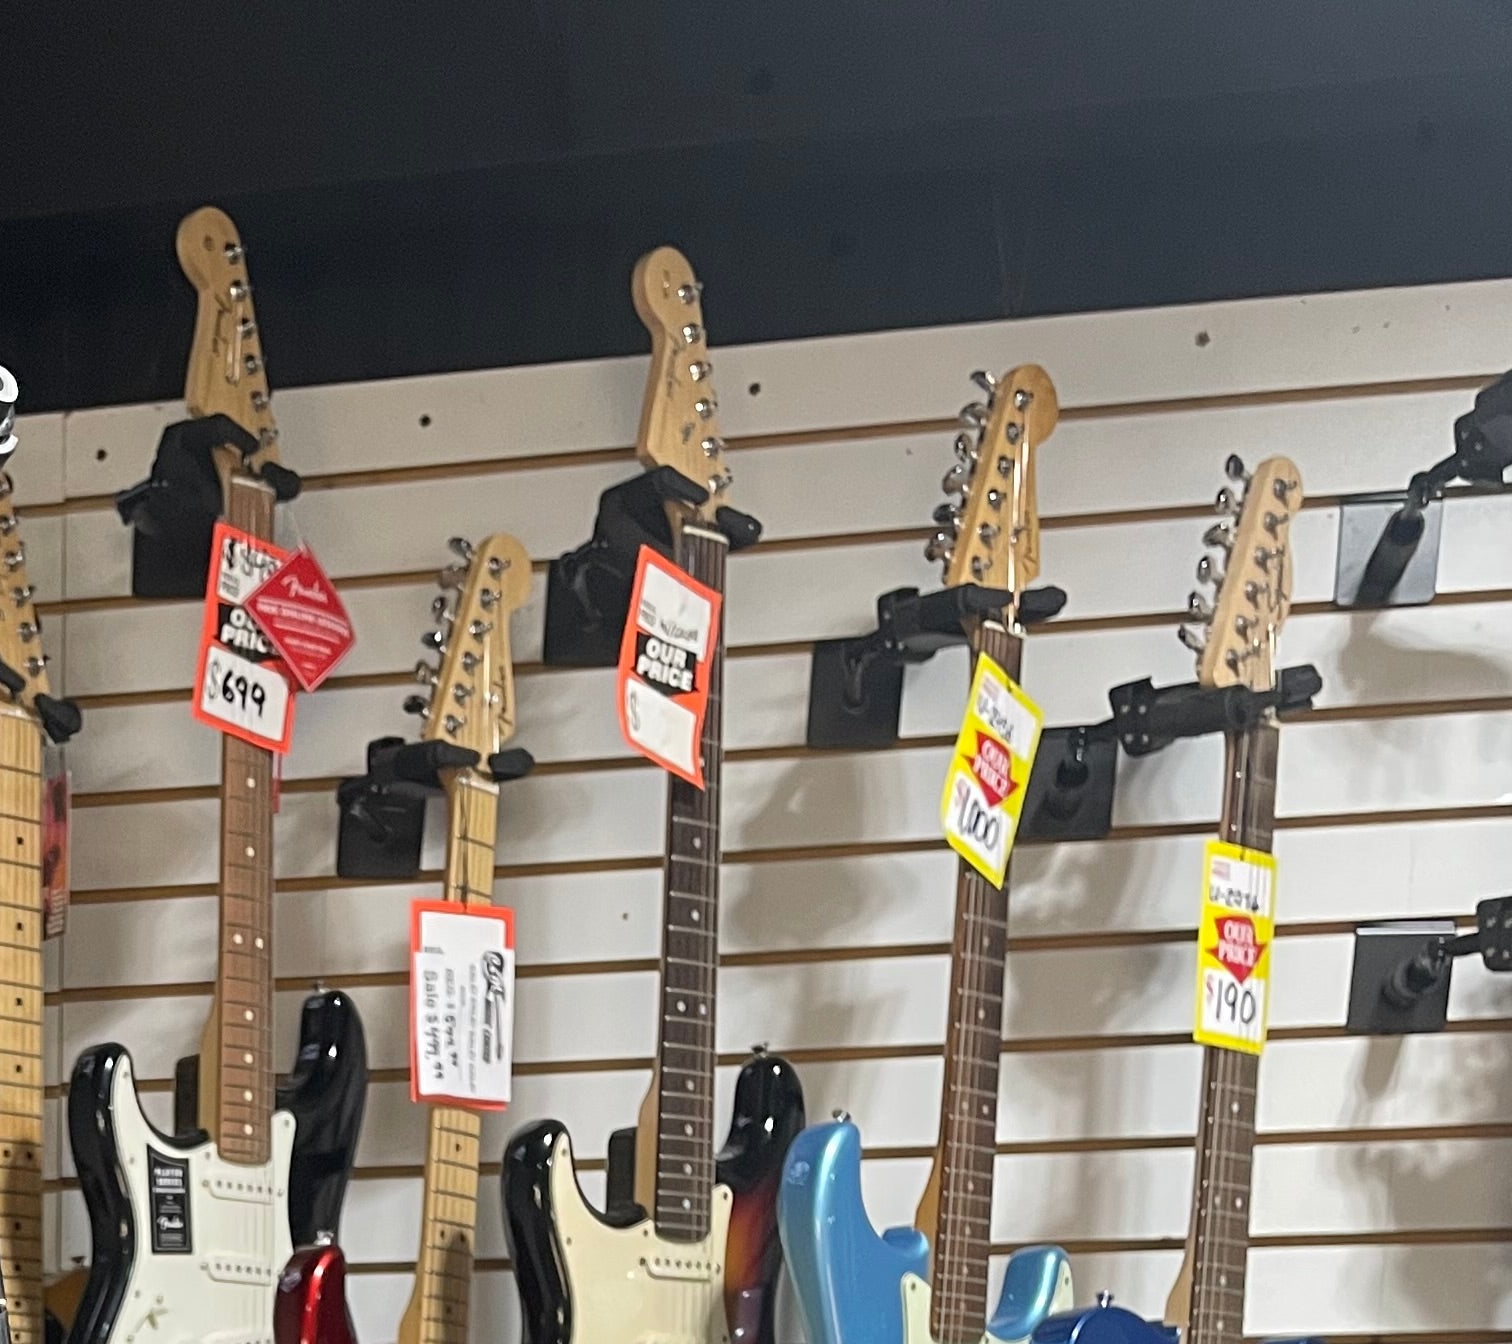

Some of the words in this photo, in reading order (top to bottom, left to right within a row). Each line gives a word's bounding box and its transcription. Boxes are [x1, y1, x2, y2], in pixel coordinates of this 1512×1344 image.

[220, 623, 279, 656] PRIC
[645, 636, 688, 670] OUR
[207, 659, 267, 719] $699
[635, 652, 694, 693] PRICE
[980, 738, 1011, 774] OUR
[973, 754, 1012, 800] PRICE
[1223, 919, 1255, 945] OUR
[1217, 940, 1258, 968] PRICE
[1205, 973, 1257, 1025] $190
